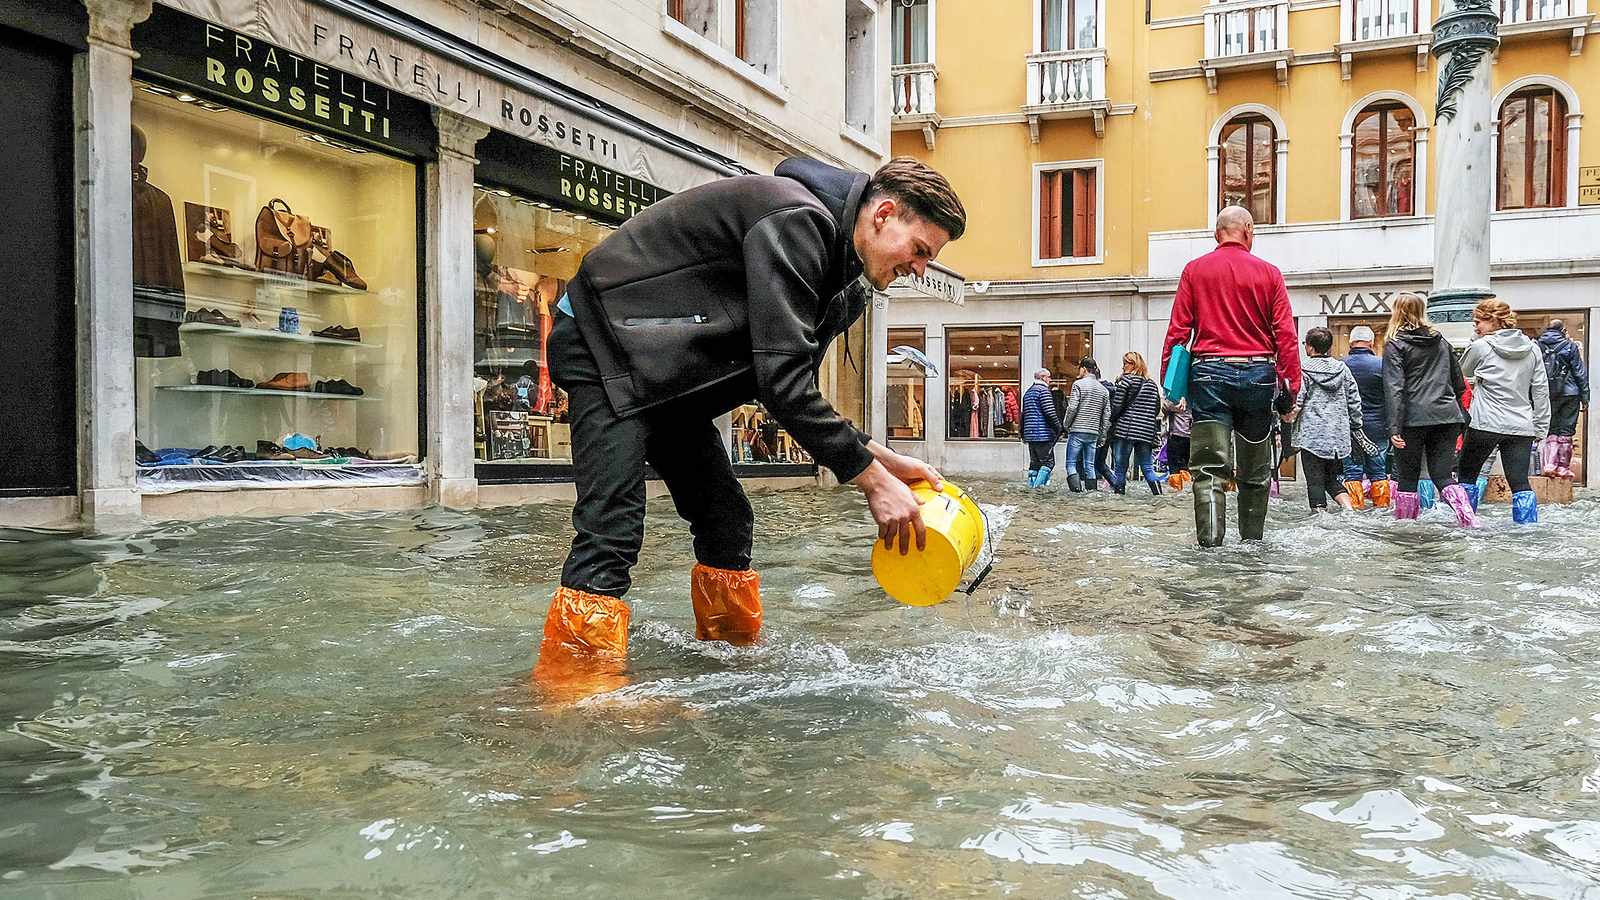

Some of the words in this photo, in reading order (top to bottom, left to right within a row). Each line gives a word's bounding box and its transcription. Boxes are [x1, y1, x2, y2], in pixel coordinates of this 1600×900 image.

[206, 24, 391, 111] FRATELLI
[206, 57, 391, 139] ROSSETTI
[314, 24, 481, 108] FRATELLI
[501, 99, 617, 160] ROSSETTI
[560, 155, 657, 204] FRATELLI
[561, 178, 648, 217] ROSSET
